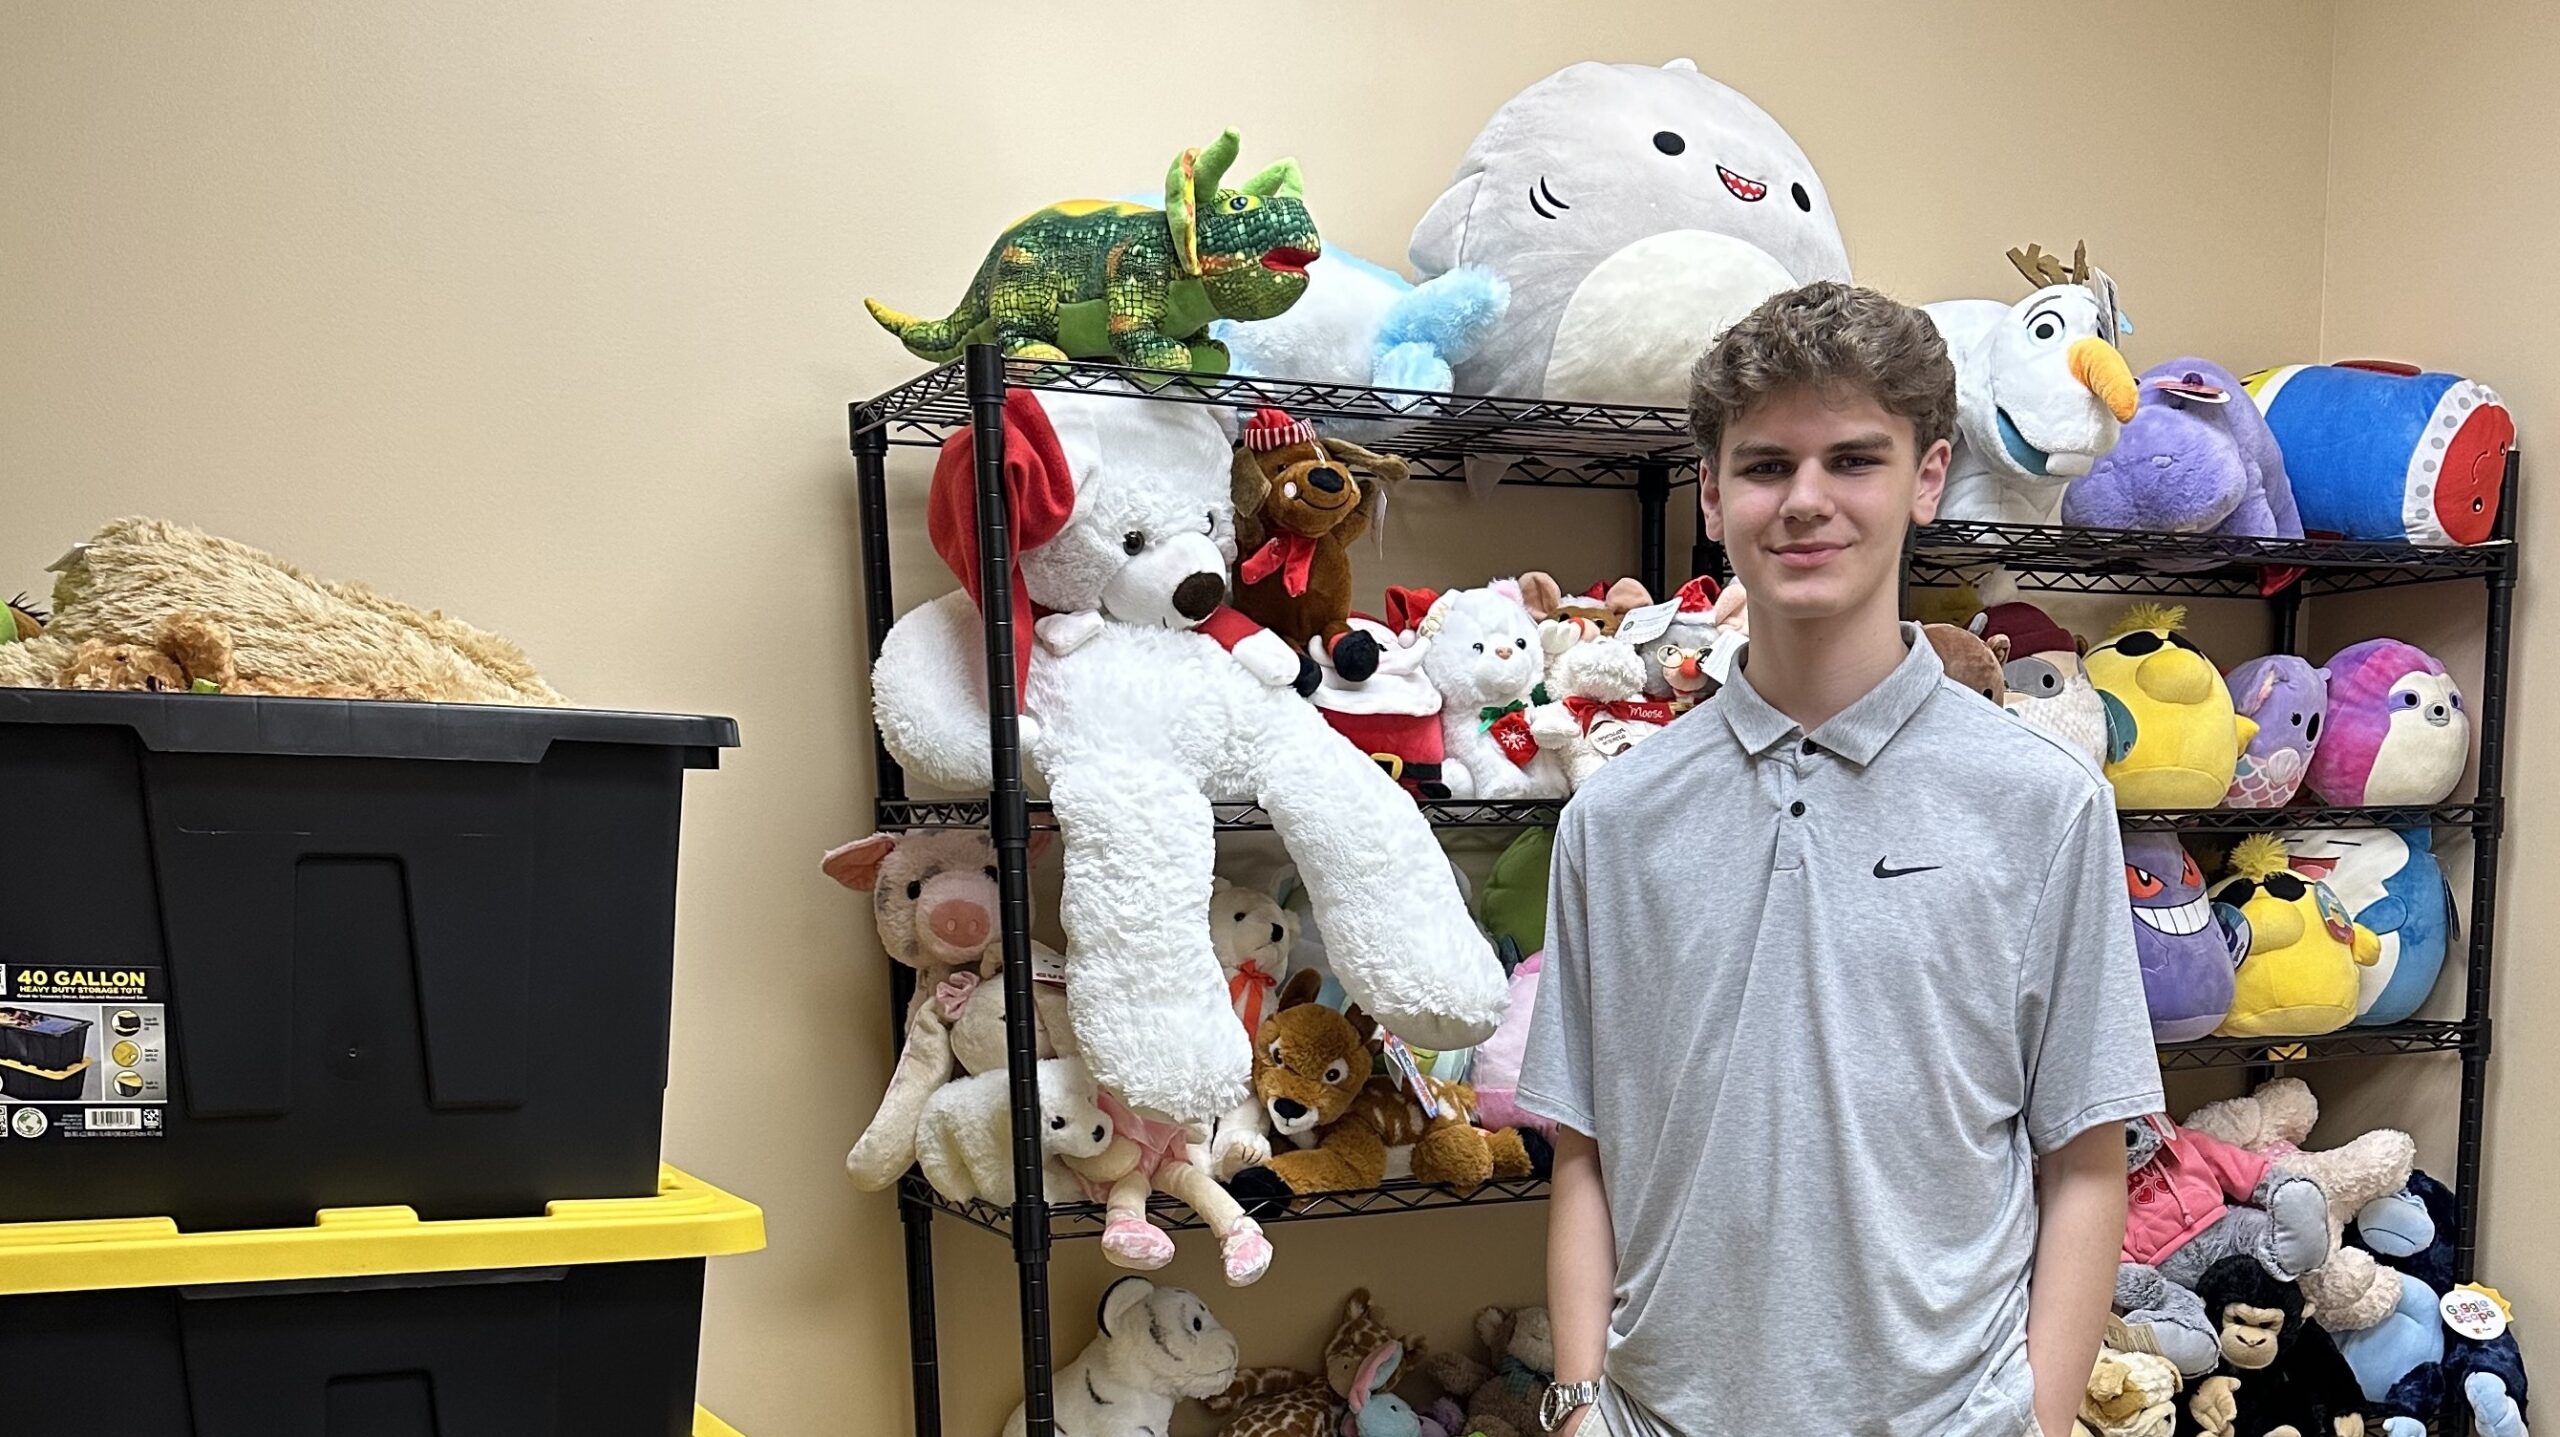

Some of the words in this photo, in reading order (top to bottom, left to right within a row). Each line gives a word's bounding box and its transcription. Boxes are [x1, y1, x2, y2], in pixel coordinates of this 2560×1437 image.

[1628, 704, 1664, 719] Moose
[17, 969, 48, 986] 40
[54, 970, 145, 987] GALLON
[19, 985, 50, 993] HEAVY
[51, 986, 76, 994] DUTY
[77, 986, 119, 995] STORAGE
[120, 987, 143, 995] TOTE
[2446, 1300, 2489, 1315] Giggle
